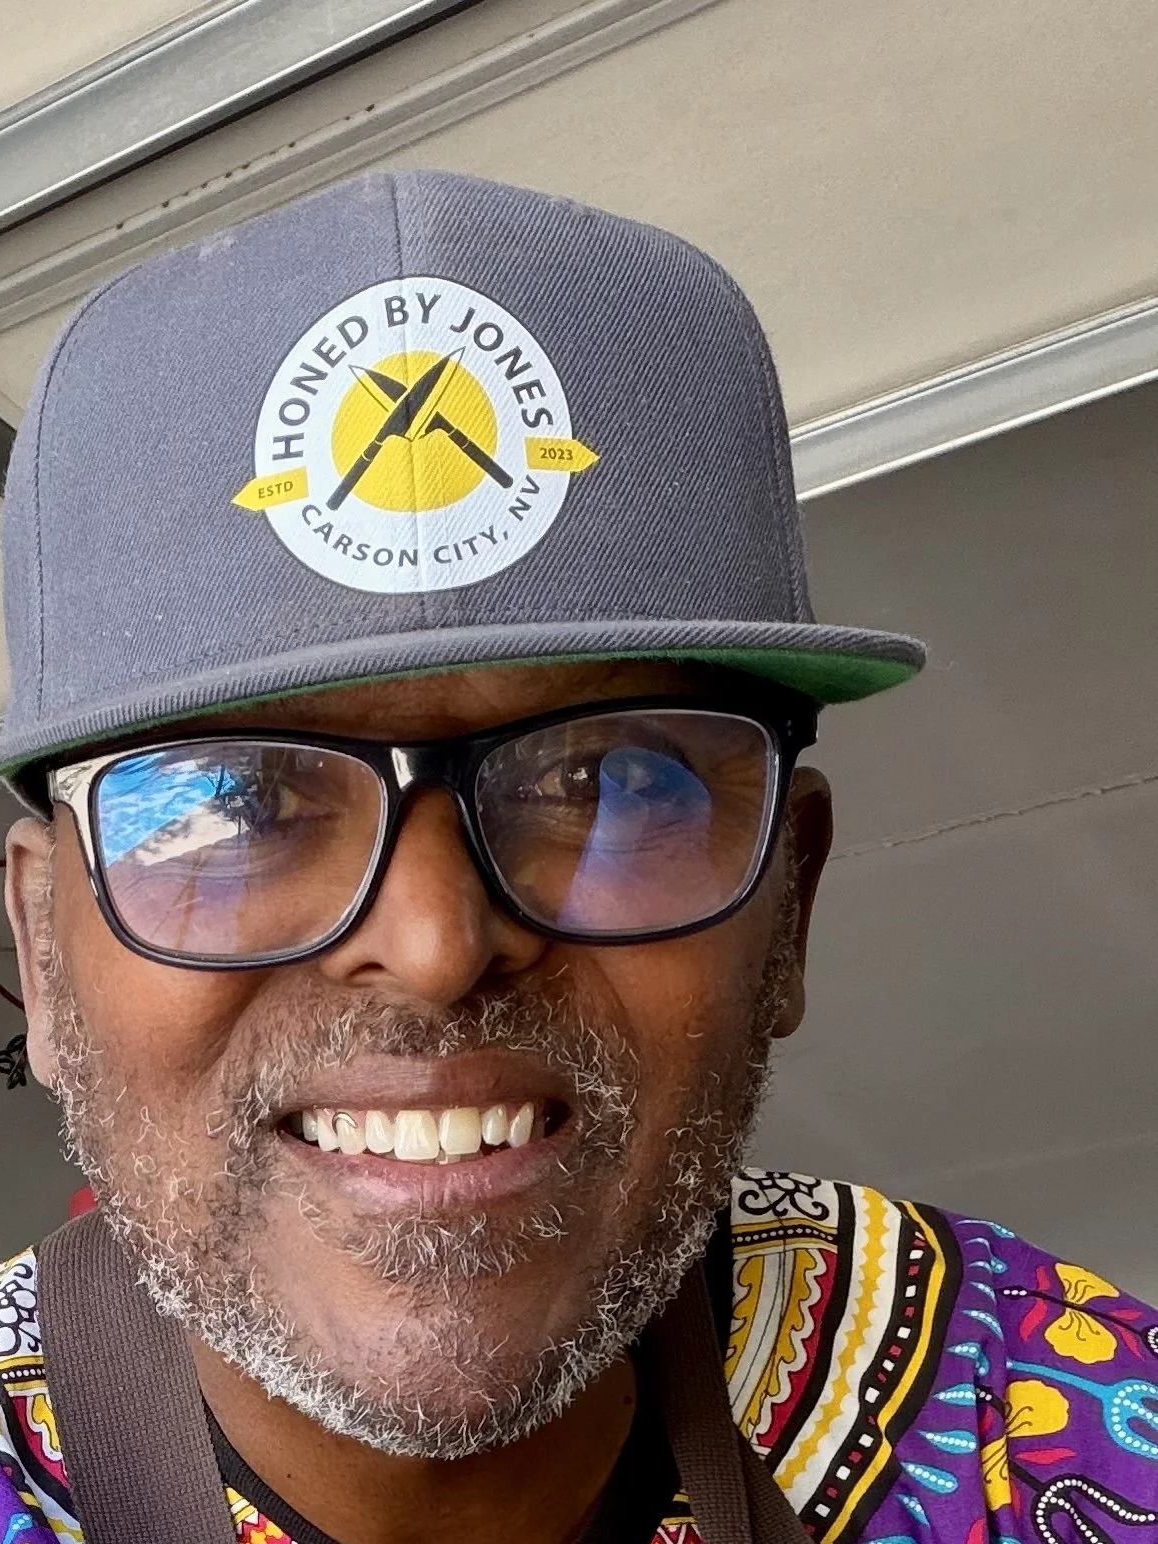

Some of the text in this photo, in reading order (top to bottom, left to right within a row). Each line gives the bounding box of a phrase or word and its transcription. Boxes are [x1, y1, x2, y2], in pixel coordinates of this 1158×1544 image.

[272, 292, 554, 460] HONED BY JONES
[539, 447, 574, 461] 2023
[257, 480, 294, 499] ESTD
[301, 474, 541, 567] CARSON CITY, NV
